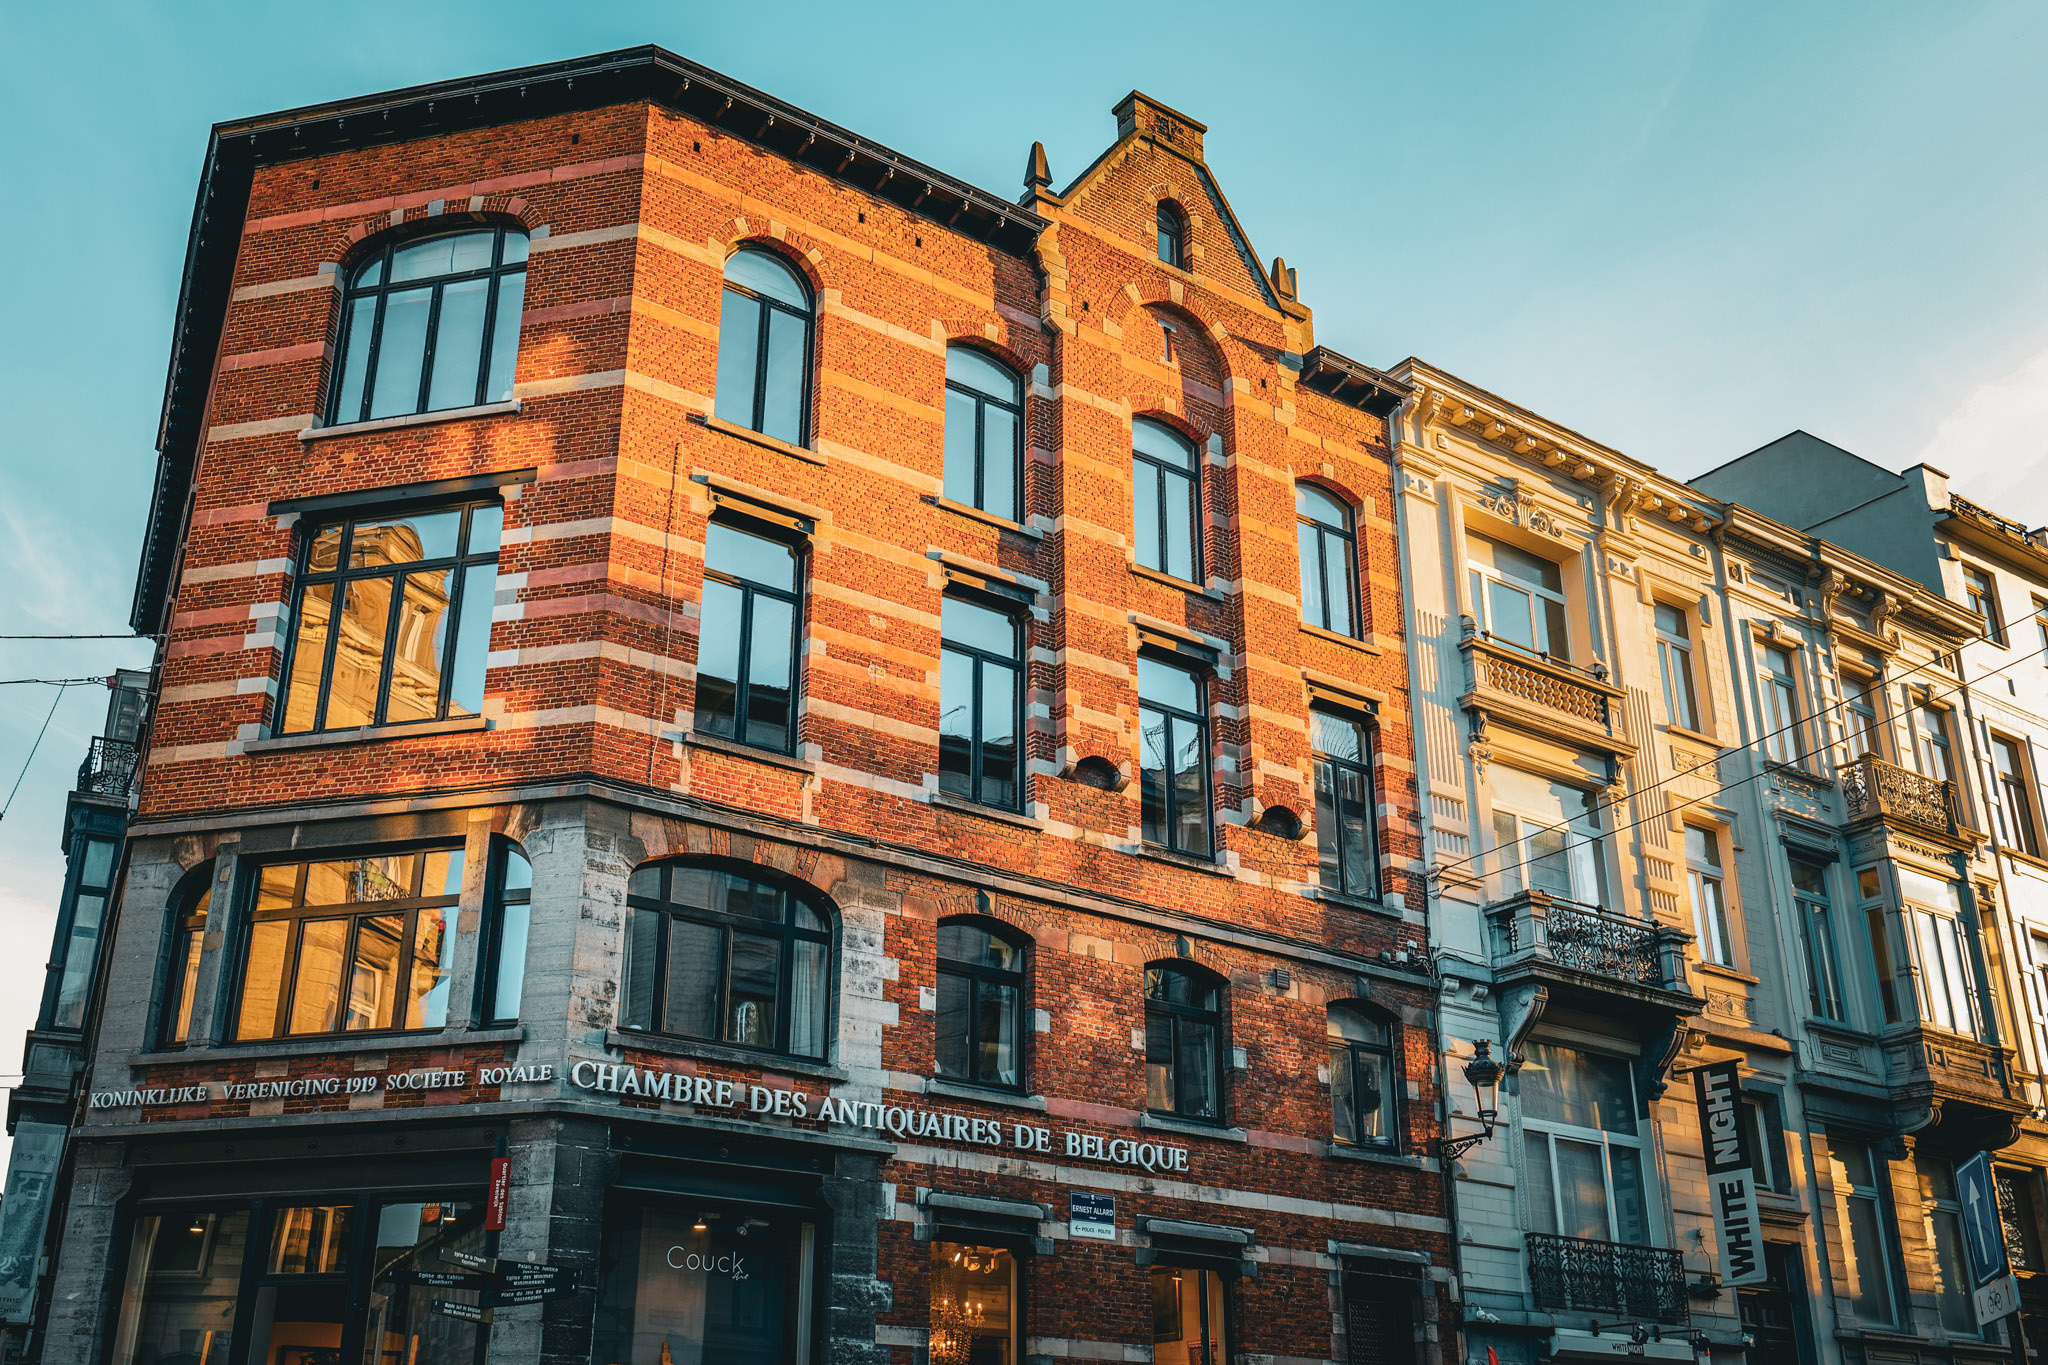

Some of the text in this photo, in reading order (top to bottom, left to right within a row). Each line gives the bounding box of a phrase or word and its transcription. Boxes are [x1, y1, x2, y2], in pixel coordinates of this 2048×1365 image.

[88, 1064, 552, 1108] KONINKLIJKE VERENIGING 1919 SOCIETE ROYALE
[572, 1060, 1190, 1174] CHAMBRE DES ANTIQUAIRES DE BELGIQUE
[1702, 1070, 1756, 1279] WHITE NIGHT
[1072, 1204, 1114, 1216] ERNEST ALLARD
[667, 1246, 744, 1274] Couck
[1612, 1342, 1644, 1354] WHITE NIGHT
